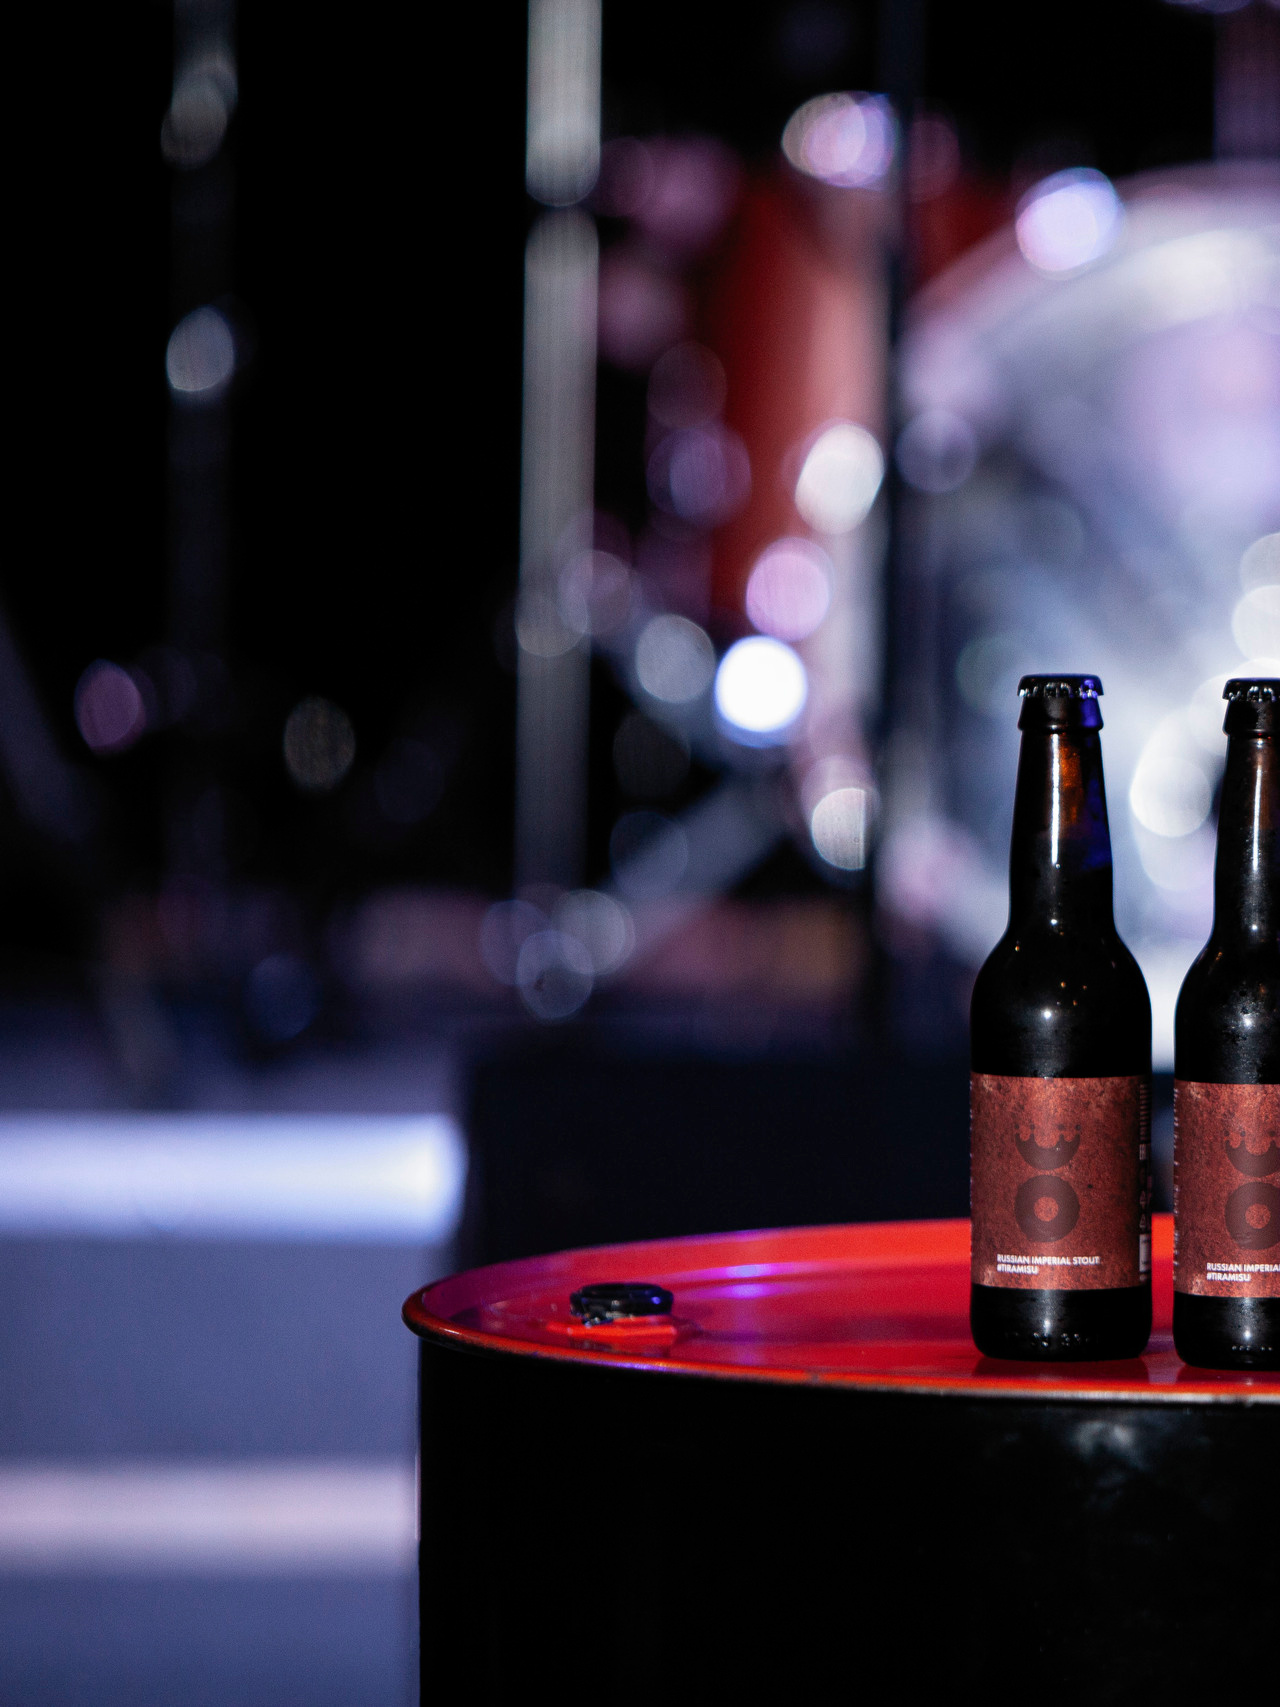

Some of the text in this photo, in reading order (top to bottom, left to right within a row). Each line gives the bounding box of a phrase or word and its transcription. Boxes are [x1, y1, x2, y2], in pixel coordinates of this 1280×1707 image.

[997, 1254, 1100, 1265] RUSSIAN IMPERIAL STOUT
[996, 1264, 1039, 1275] #TIRAMISU
[1206, 1262, 1242, 1272] RUSSIAN
[1206, 1272, 1251, 1282] #TIRAMISU
